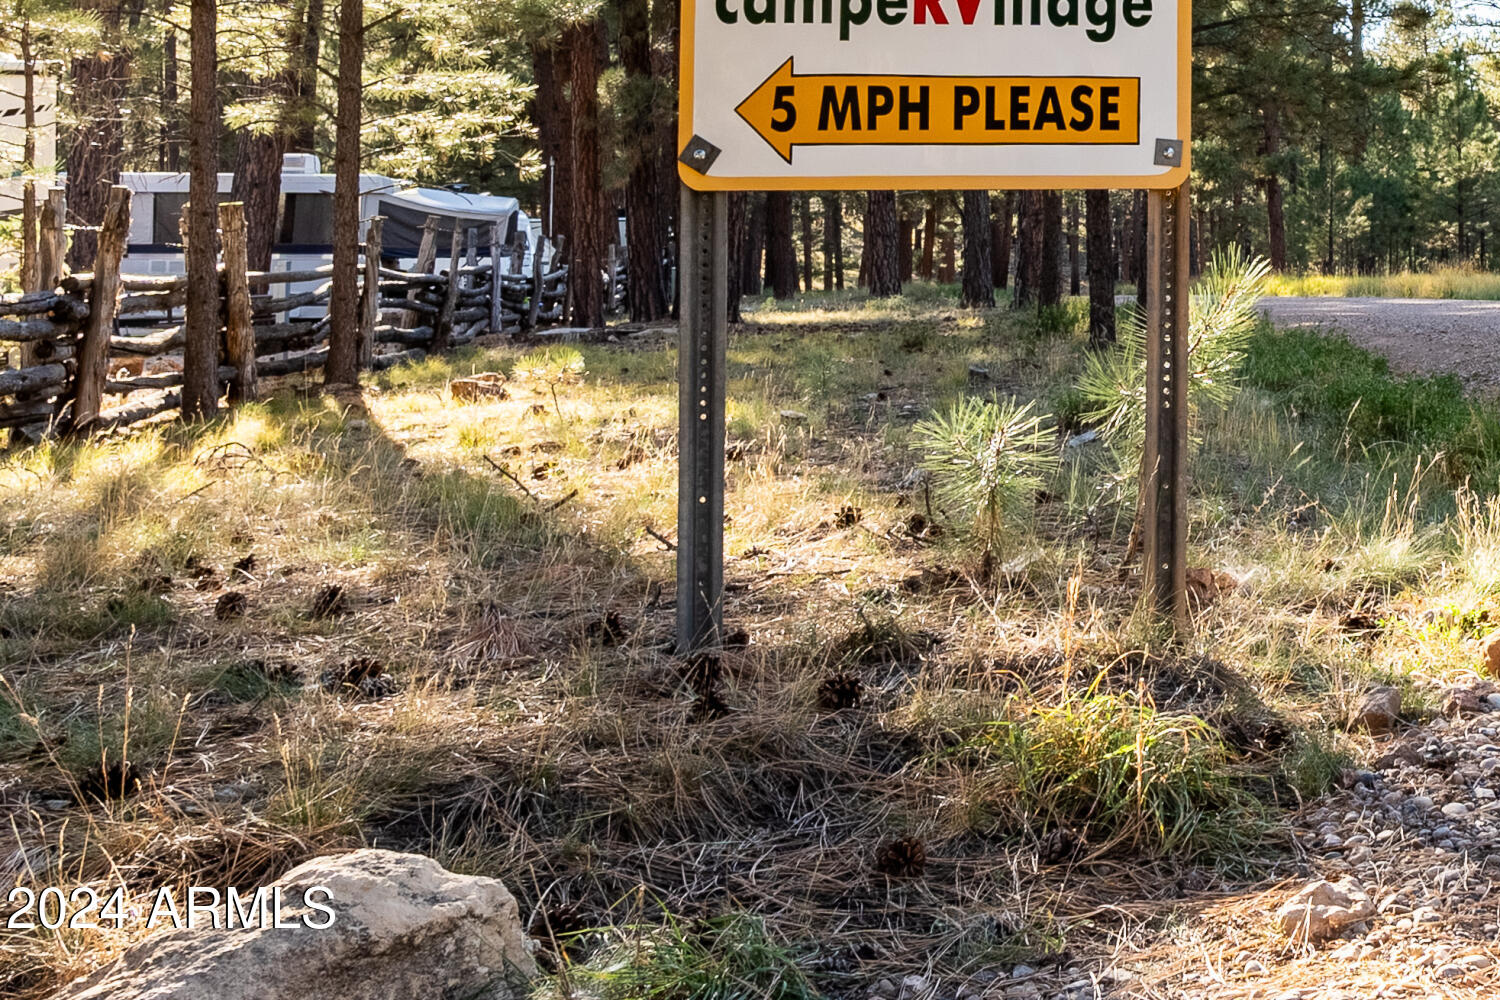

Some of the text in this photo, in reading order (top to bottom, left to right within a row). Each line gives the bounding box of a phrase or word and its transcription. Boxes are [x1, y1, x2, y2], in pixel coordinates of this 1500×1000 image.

[770, 84, 1121, 132] 5 MPH PLEASE
